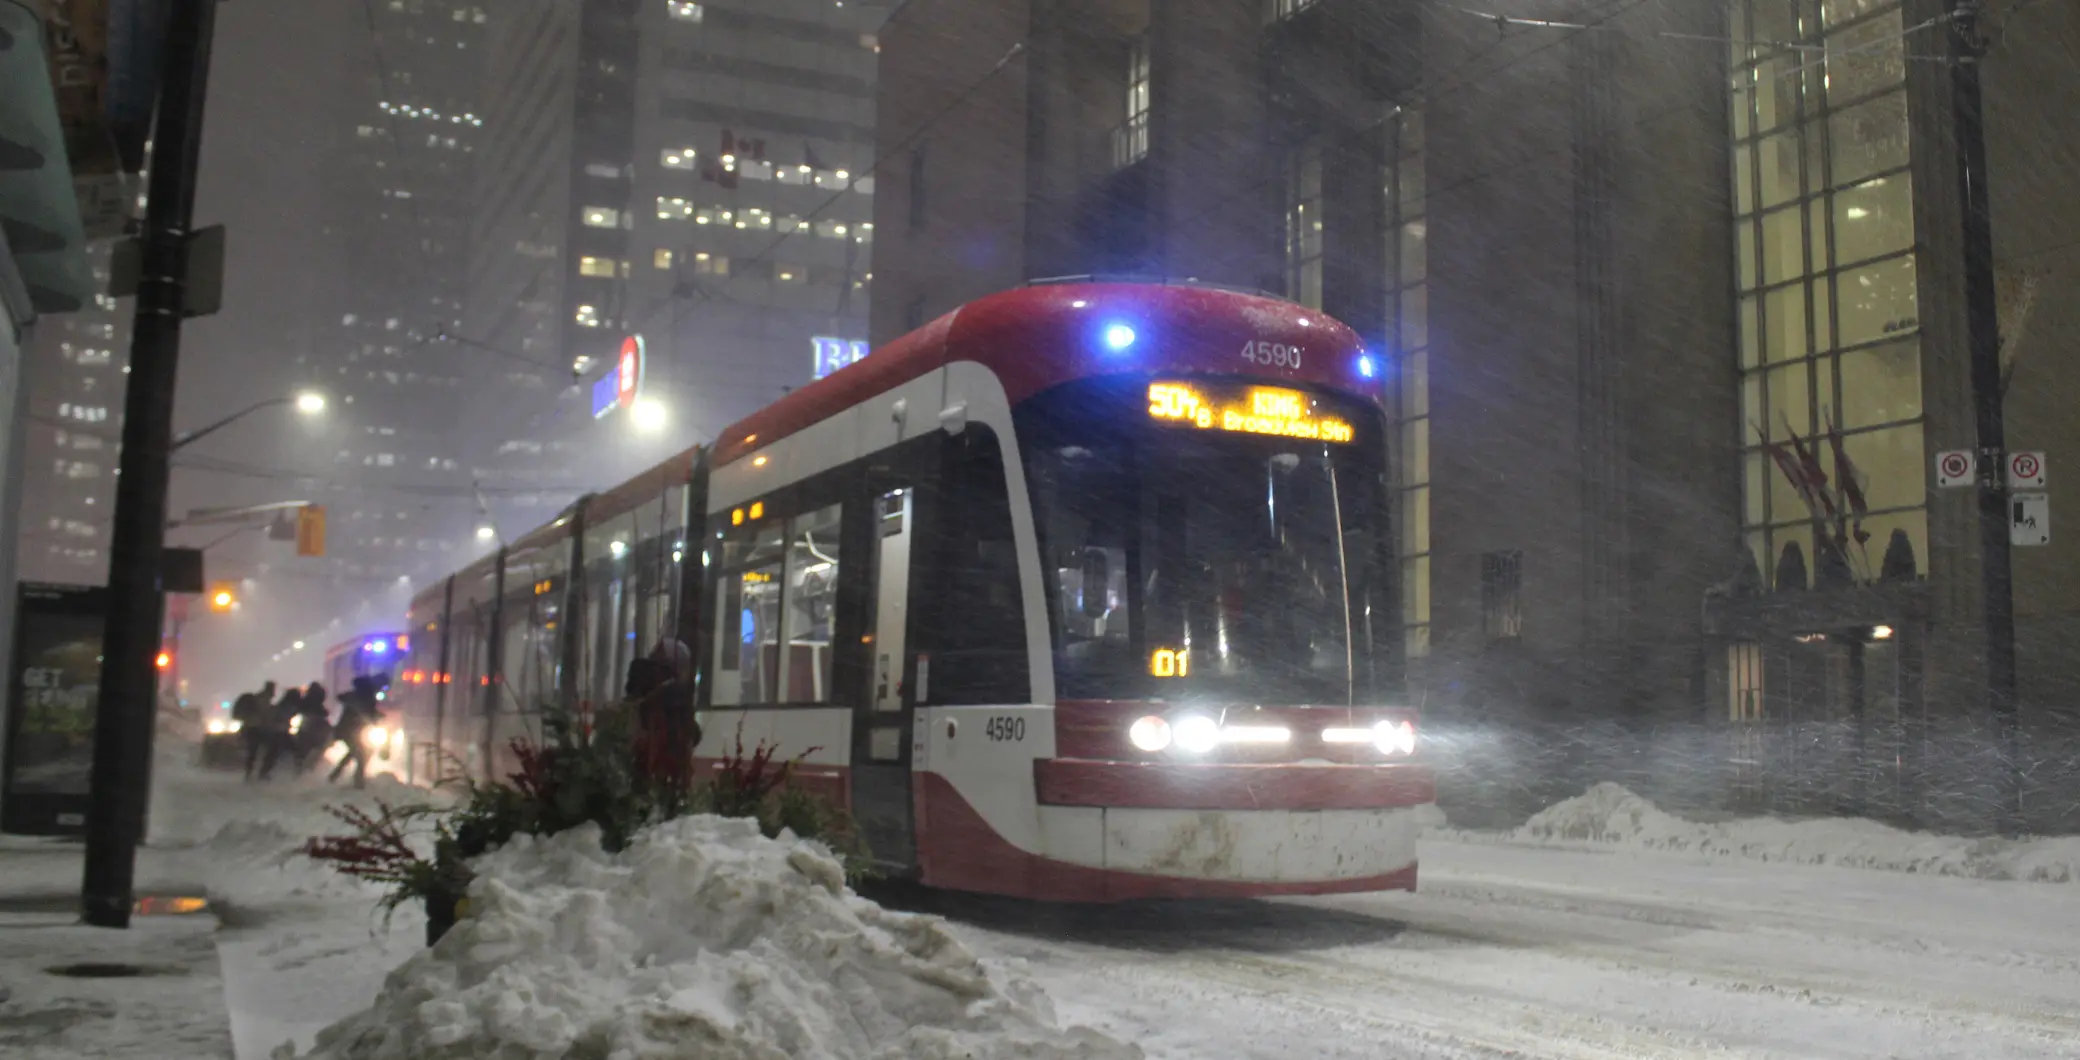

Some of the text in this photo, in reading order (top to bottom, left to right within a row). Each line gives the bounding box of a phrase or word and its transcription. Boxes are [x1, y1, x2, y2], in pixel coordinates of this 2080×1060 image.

[1241, 340, 1301, 369] 4590
[1252, 389, 1302, 419] KING
[1321, 419, 1351, 442] Stn
[1152, 649, 1187, 677] 01
[986, 716, 1025, 742] 4590
